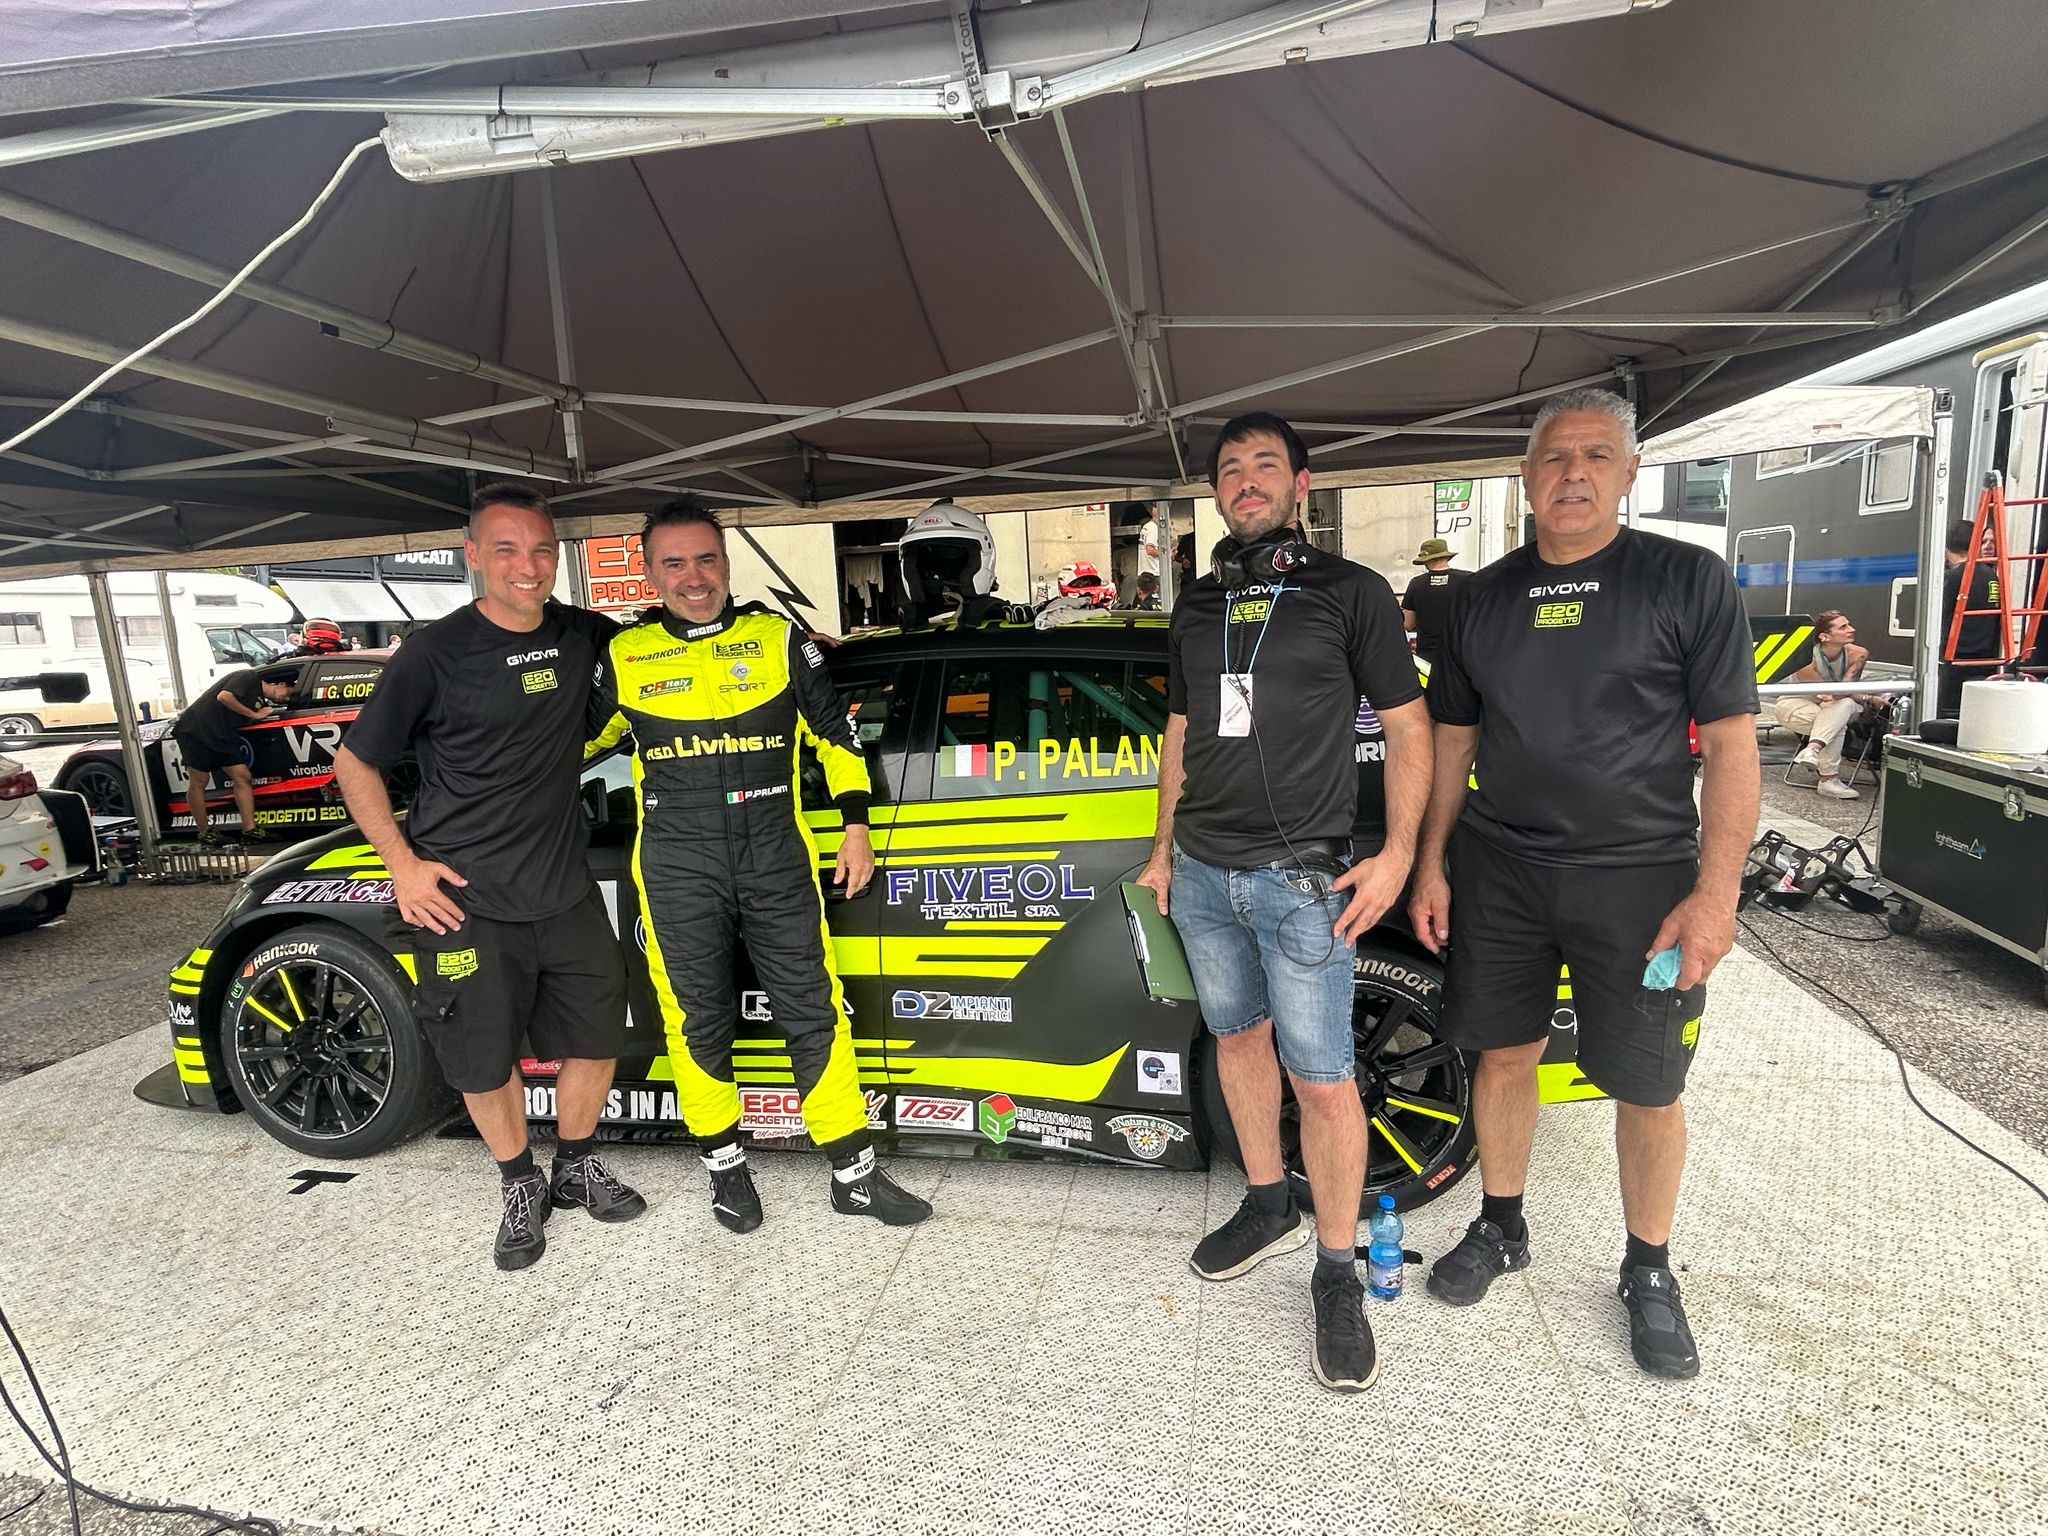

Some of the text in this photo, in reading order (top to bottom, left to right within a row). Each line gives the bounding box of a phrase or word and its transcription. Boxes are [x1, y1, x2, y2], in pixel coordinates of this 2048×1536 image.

[394, 550, 454, 565] DUCATI
[1529, 581, 1600, 598] GIVOVA
[1539, 604, 1581, 619] E20
[1537, 616, 1578, 626] PROGETTO
[506, 648, 559, 666] GIVOVA
[524, 671, 554, 686] E20
[666, 679, 690, 688] Italy
[327, 685, 340, 699] G.
[719, 682, 768, 693] SPORT
[994, 741, 1026, 781] P.
[320, 806, 347, 820] E20
[886, 864, 1095, 905] FIVEOL
[921, 903, 1060, 919] TEXTIL SPA
[440, 952, 474, 966] E20
[951, 996, 1011, 1010] IMPIANTI
[953, 1008, 1012, 1021] ELETTRICI
[630, 1091, 655, 1119] IN
[744, 1095, 801, 1113] E20
[899, 1098, 967, 1121] TOSI
[743, 1115, 803, 1125] PROGETTO
[1017, 1107, 1092, 1130] EDILFRANCO MAR
[1117, 1117, 1150, 1129] Natura
[1157, 1123, 1175, 1134] vita
[1017, 1121, 1092, 1141] COSTRUZIONI
[1041, 1135, 1069, 1148] EDILI
